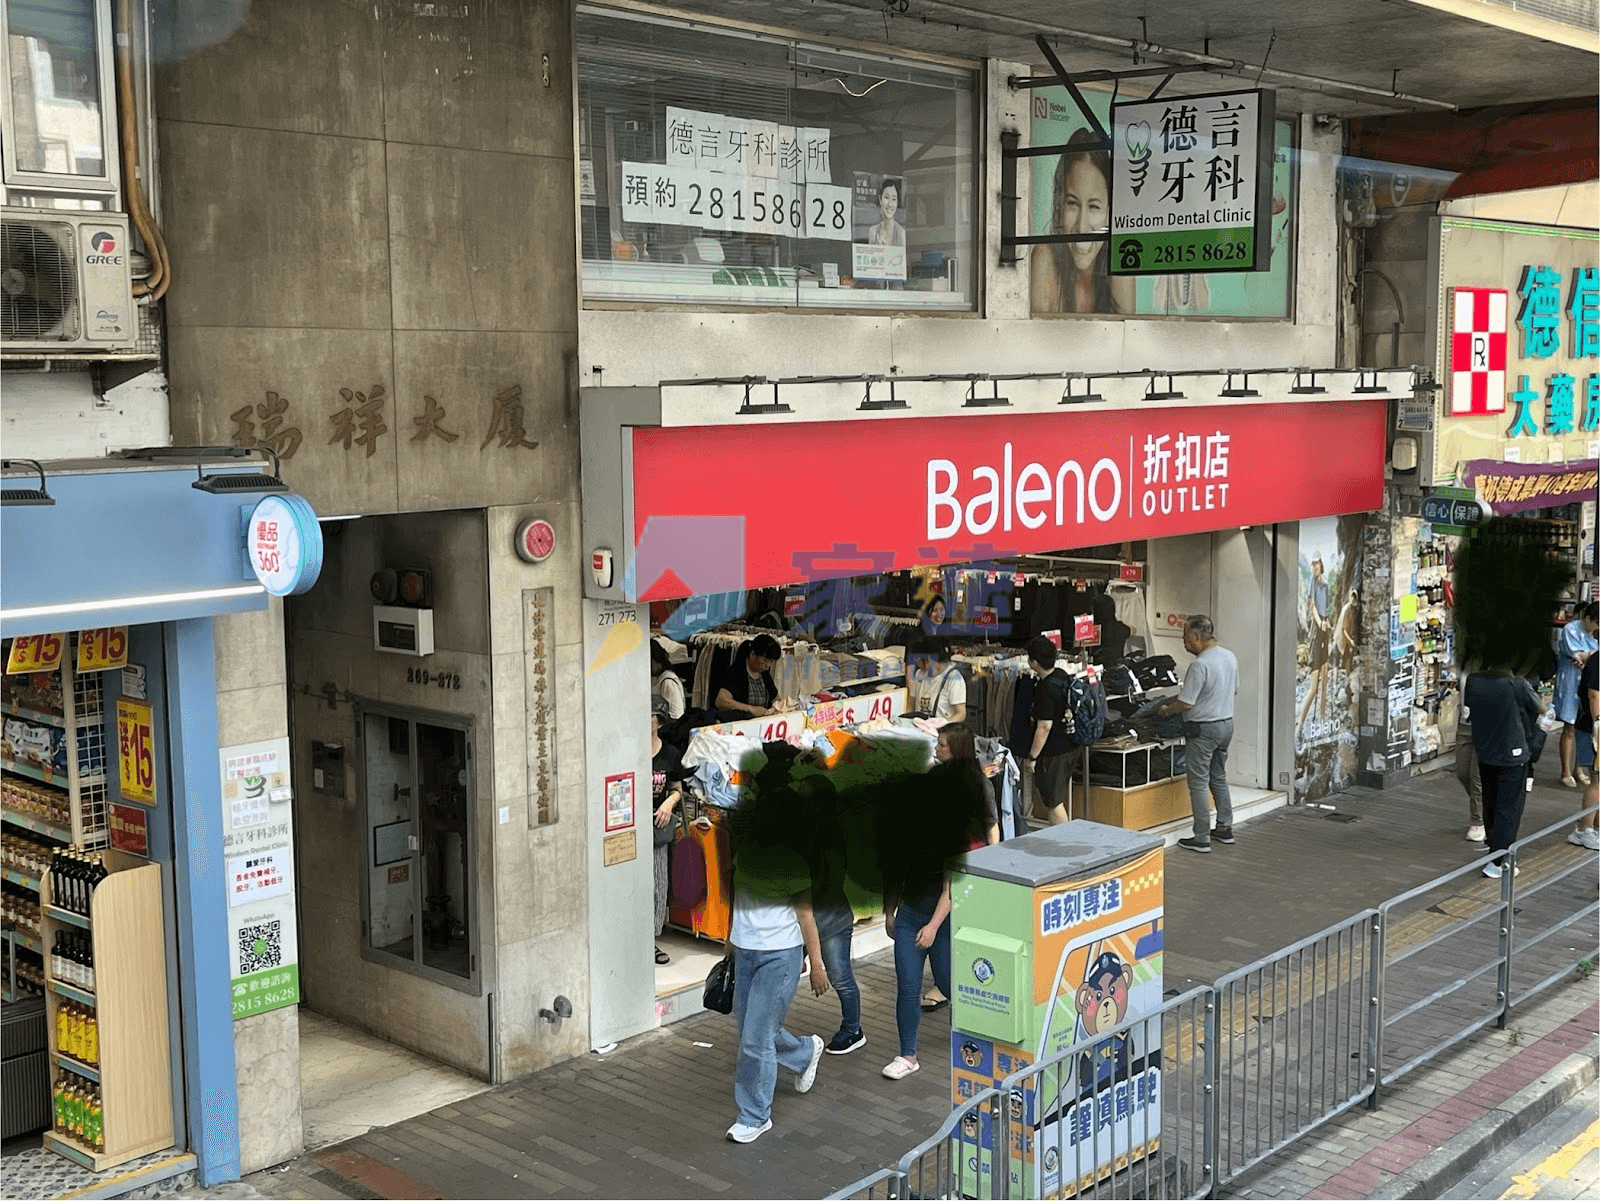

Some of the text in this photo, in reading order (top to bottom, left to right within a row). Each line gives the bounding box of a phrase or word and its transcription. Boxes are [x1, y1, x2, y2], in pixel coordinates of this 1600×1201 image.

[668, 119, 829, 173] 德言牙科診所
[1159, 101, 1246, 154] 德言
[625, 175, 677, 208] 預約
[689, 183, 846, 230] 28158628
[1158, 154, 1244, 204] 牙科
[1114, 207, 1251, 229] Wisdom Dental Clinic
[86, 255, 122, 266] GREE
[1153, 242, 1247, 264] 2815 8628
[231, 384, 539, 459] 瑞祥大廈
[1143, 430, 1230, 485] 折扣店
[927, 441, 1122, 541] Baleno
[1142, 483, 1229, 517] OUTLET
[598, 610, 637, 626] 271 273
[1043, 879, 1119, 932] 時刻專注
[264, 987, 295, 1006] 8628
